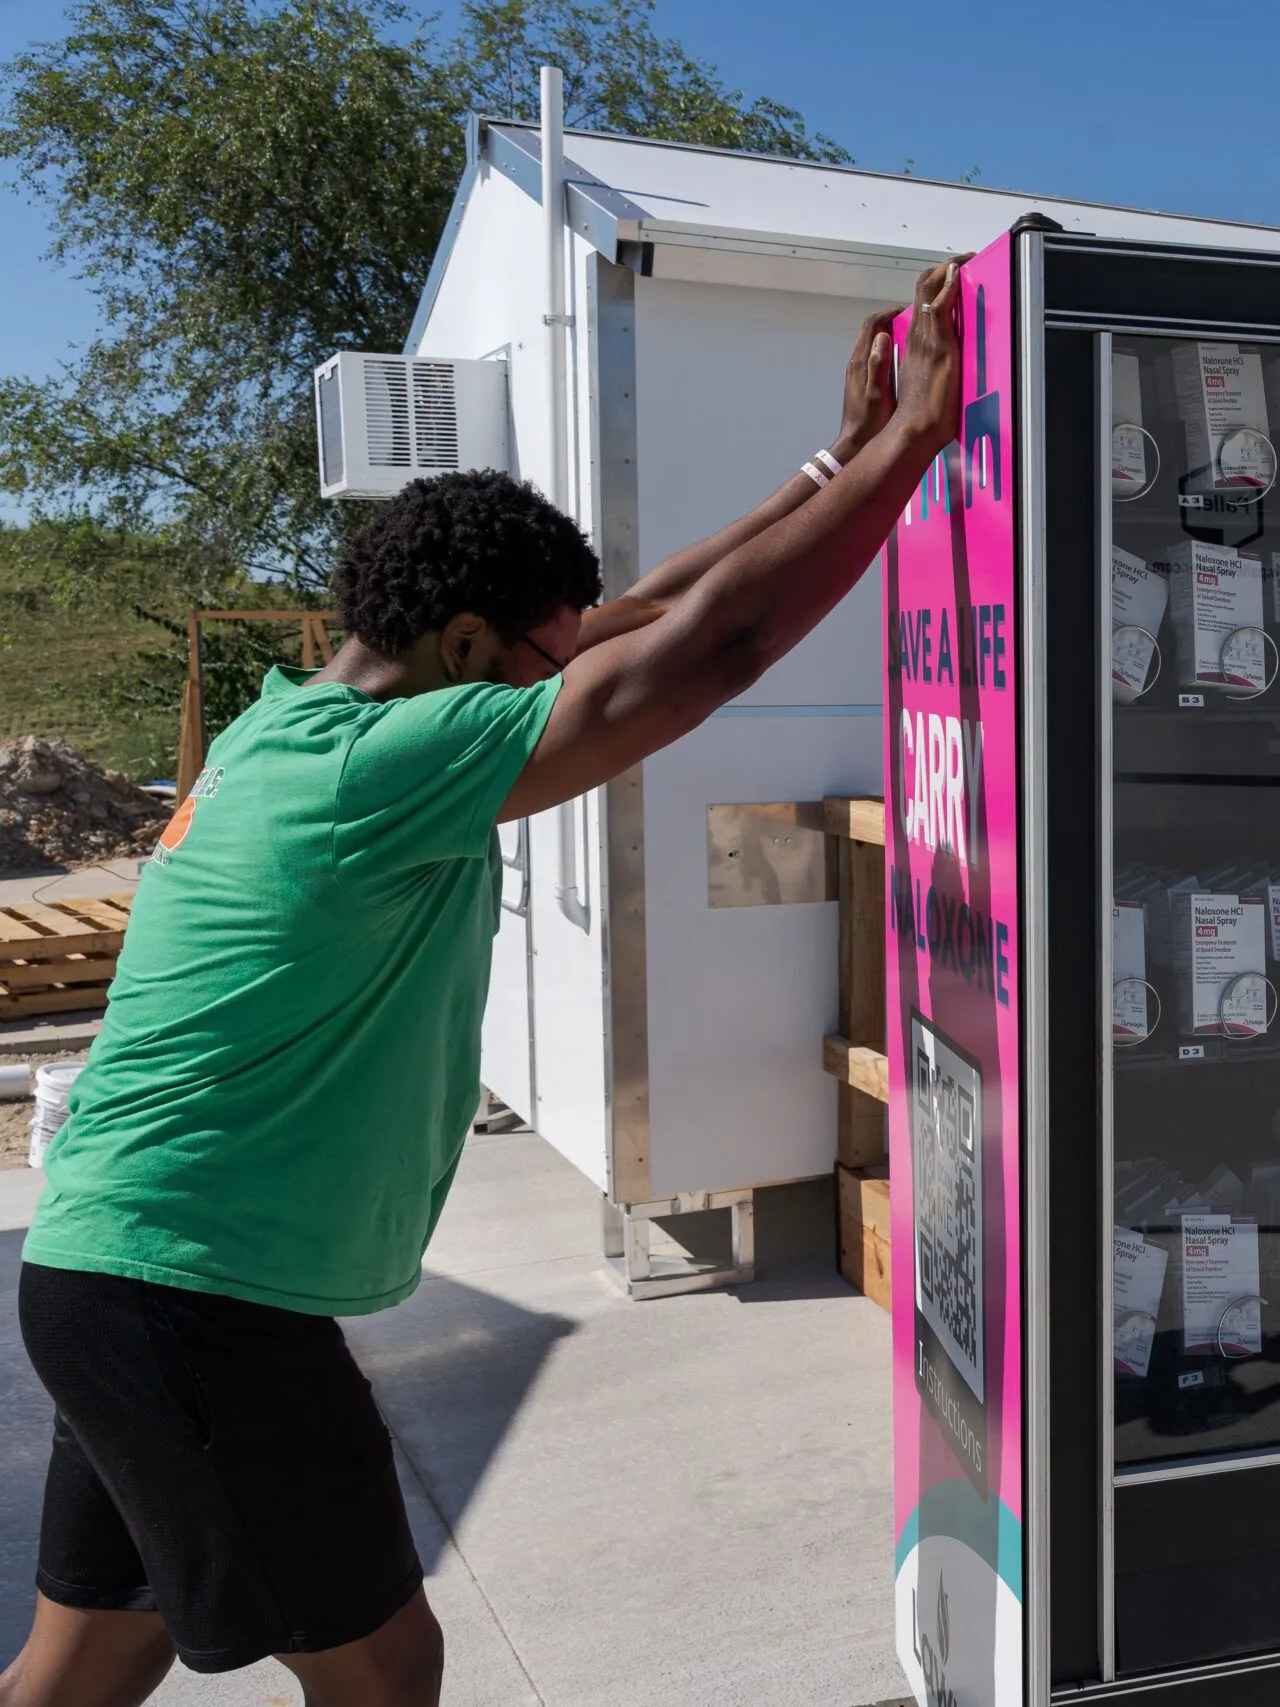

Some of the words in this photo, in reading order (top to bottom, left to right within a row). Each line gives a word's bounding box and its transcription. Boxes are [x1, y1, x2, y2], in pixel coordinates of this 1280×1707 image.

[1203, 356, 1232, 365] Naloxone
[1233, 357, 1244, 365] HCl
[1204, 366, 1221, 374] Nasal
[1222, 367, 1239, 376] Spray
[1196, 554, 1228, 566] Naloxone
[1230, 560, 1241, 569] HCl
[1116, 570, 1138, 584] Spray
[1134, 567, 1148, 580] HCl
[1196, 563, 1215, 574] Nasal
[1217, 565, 1235, 578] Spray
[888, 608, 932, 686] SAVE
[937, 607, 954, 686] A
[957, 604, 1006, 690] LIFE
[899, 706, 984, 872] CARRY
[1195, 907, 1230, 916] Naloxone
[1231, 908, 1243, 916] HCl
[1196, 917, 1216, 925] Nasal
[1217, 917, 1237, 926] Spray
[889, 864, 1009, 1009] NALOXONE
[1185, 1227, 1220, 1235] Naloxone
[1222, 1227, 1234, 1235] HCl
[1186, 1236, 1206, 1244] Nasal
[1208, 1236, 1228, 1246] Spray
[1116, 1248, 1137, 1262] Spray
[1132, 1245, 1145, 1254] HCl
[919, 1340, 982, 1472] Instructions
